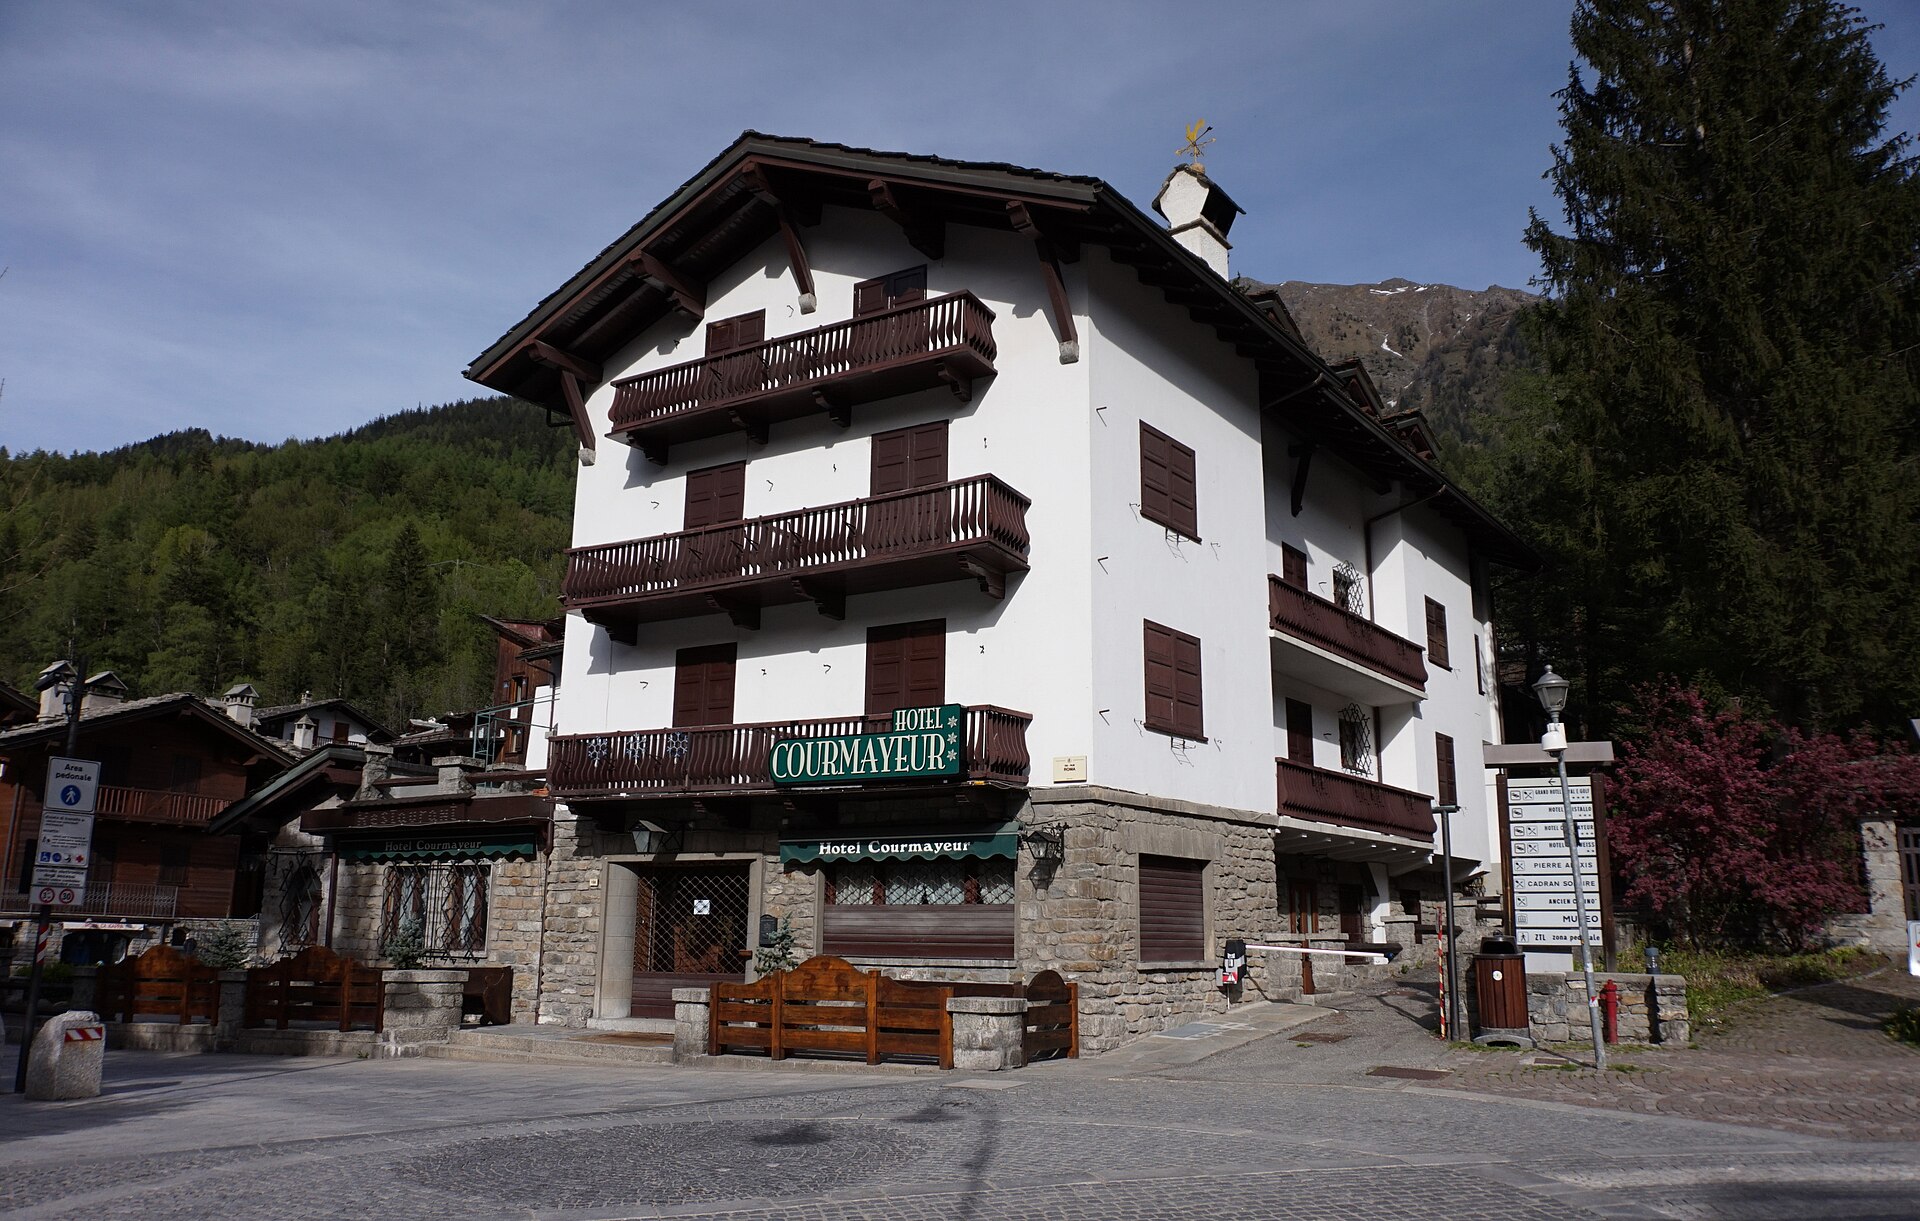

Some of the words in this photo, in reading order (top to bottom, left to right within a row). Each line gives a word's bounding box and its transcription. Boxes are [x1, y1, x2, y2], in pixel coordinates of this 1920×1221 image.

[894, 707, 943, 732] HOTEL
[772, 733, 946, 779] COURMAYEUR
[64, 763, 83, 772] Area
[55, 772, 92, 782] pedonale
[385, 841, 412, 851] Hotel
[416, 840, 482, 851] Courmayeur
[819, 841, 861, 855] Hotel
[868, 840, 971, 856] Courmayeur
[1562, 915, 1599, 923] MUEO
[1569, 934, 1600, 942] pedale
